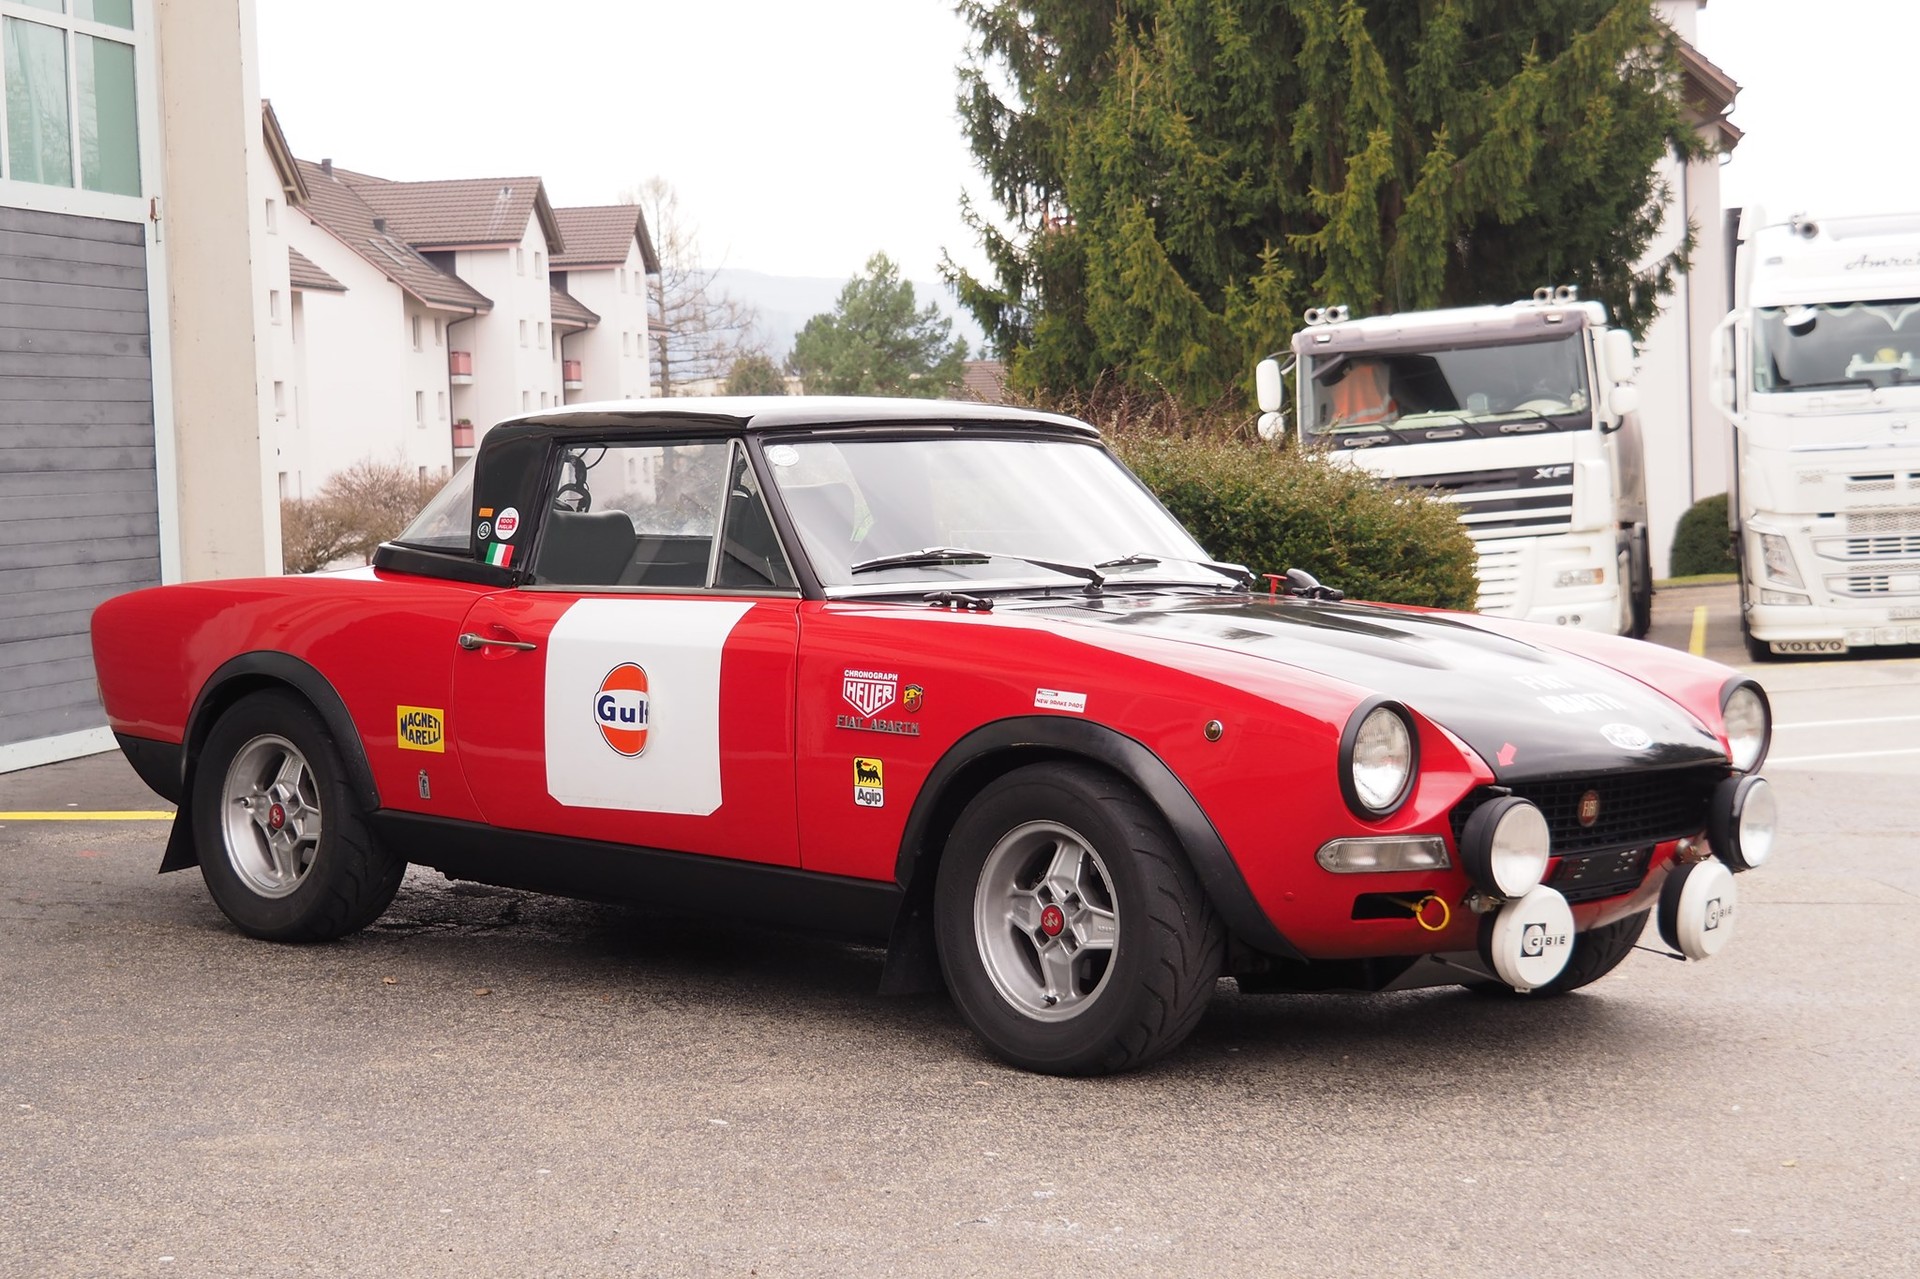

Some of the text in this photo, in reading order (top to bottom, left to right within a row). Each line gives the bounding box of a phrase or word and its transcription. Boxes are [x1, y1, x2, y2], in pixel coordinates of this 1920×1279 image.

[1532, 465, 1572, 479] XF
[1776, 641, 1842, 652] VOLVO
[844, 669, 898, 681] CHRONOGRAPH
[846, 681, 893, 714] HEUER
[400, 711, 441, 740] MAGNETI
[837, 715, 919, 734] FIAT ABARTH
[857, 788, 882, 805] Agip
